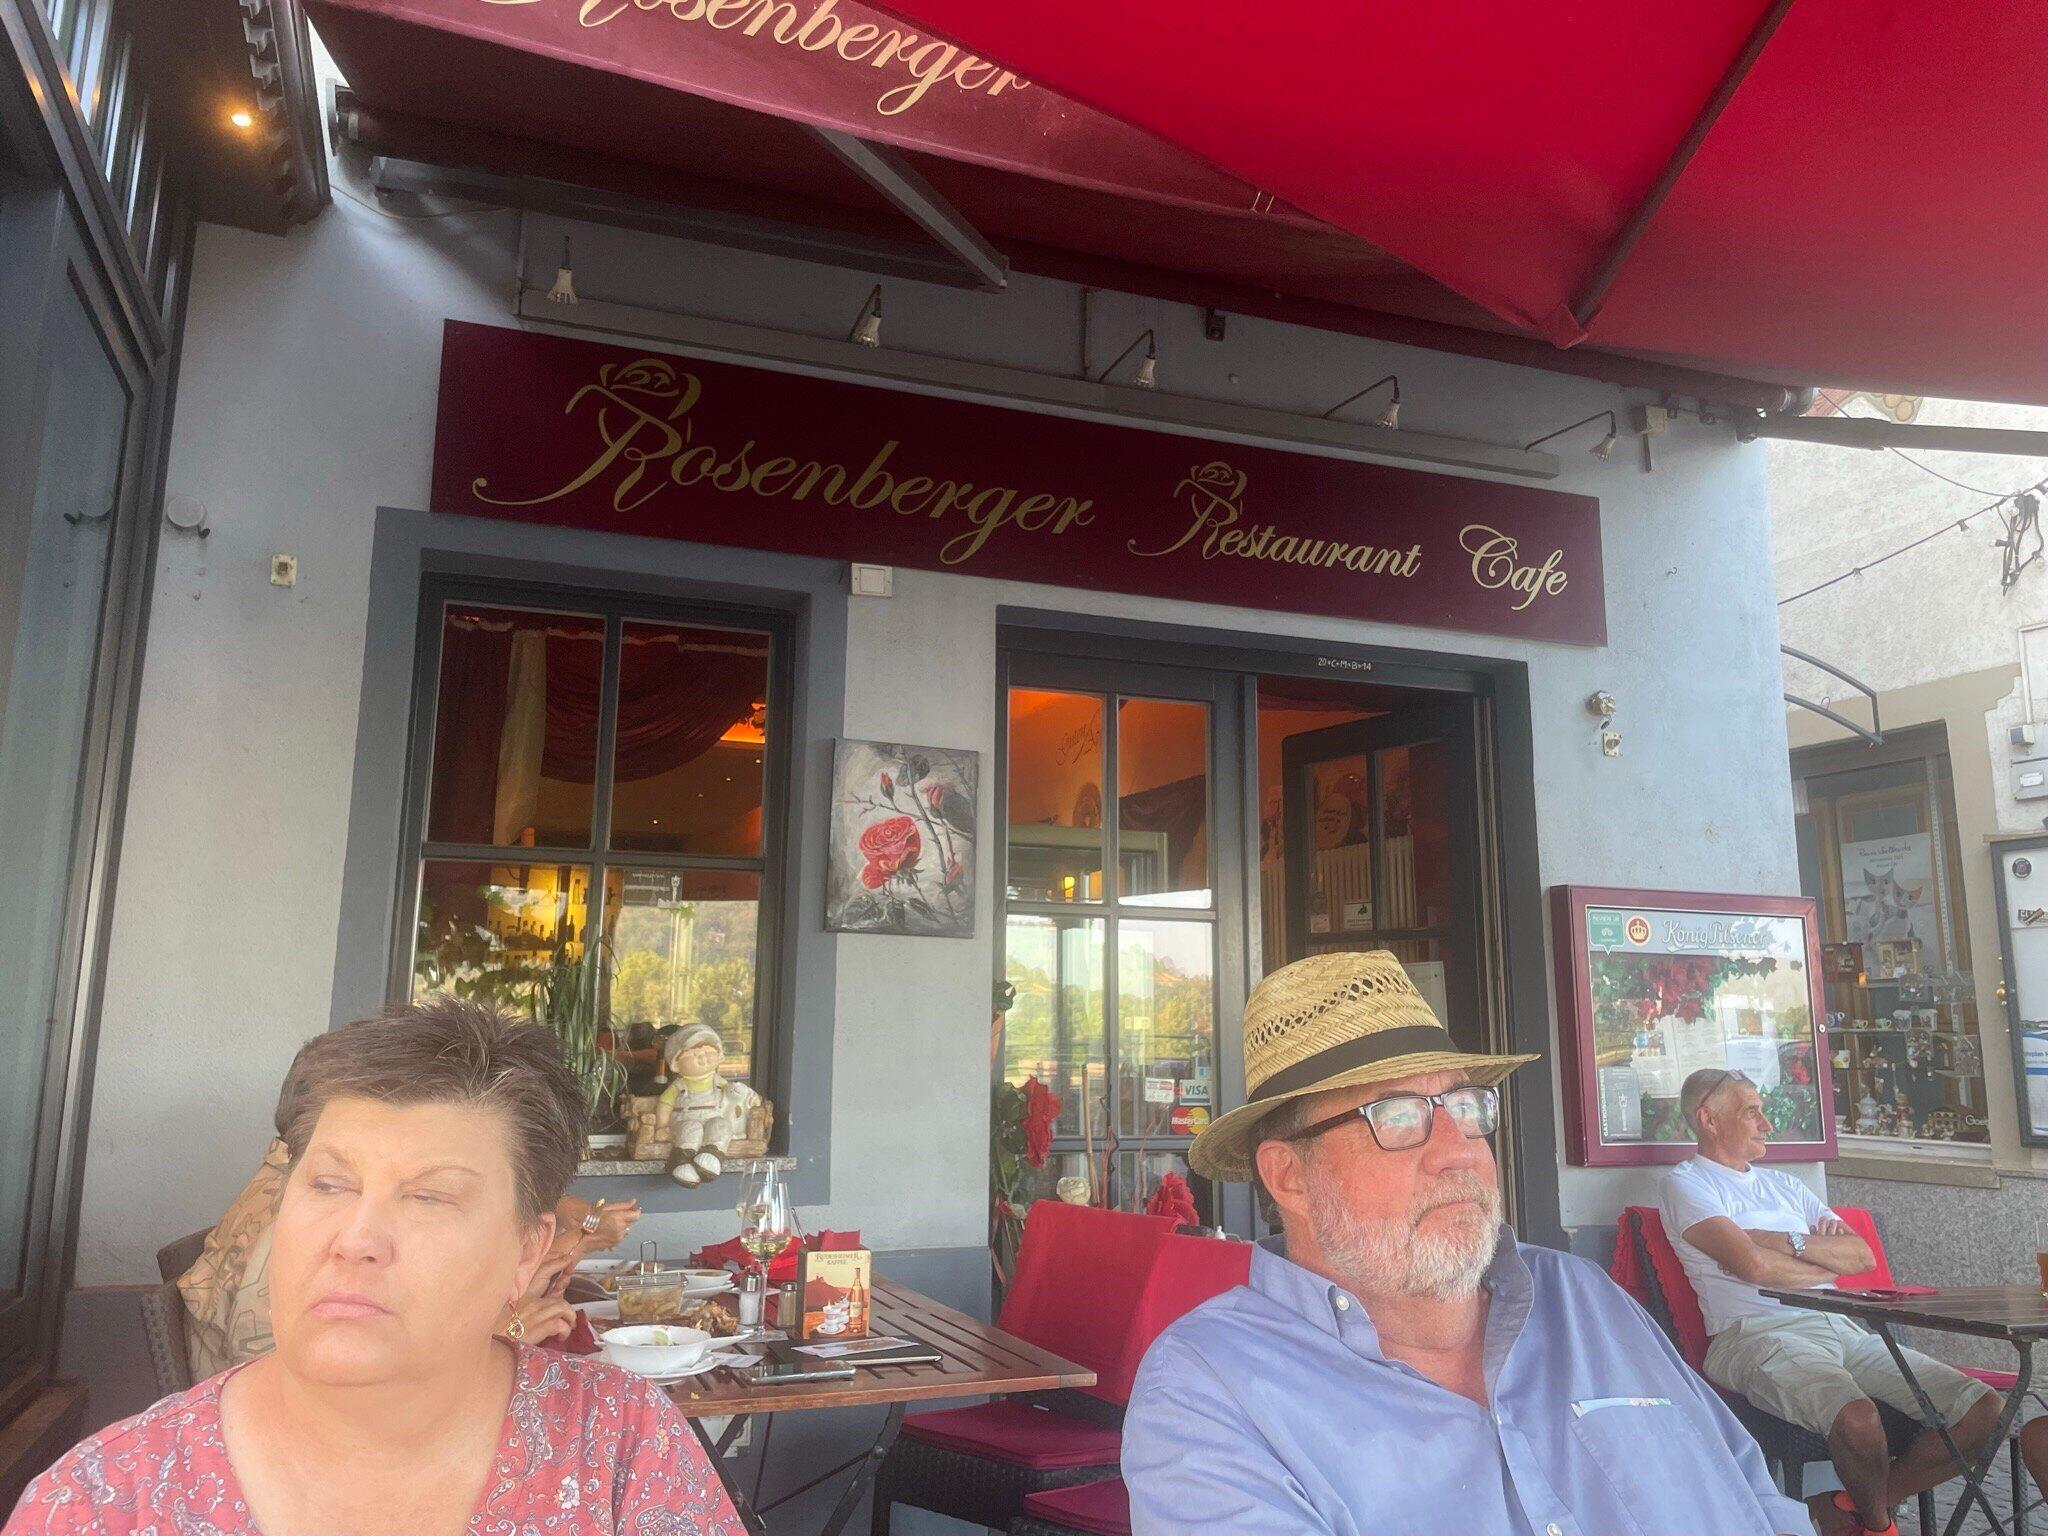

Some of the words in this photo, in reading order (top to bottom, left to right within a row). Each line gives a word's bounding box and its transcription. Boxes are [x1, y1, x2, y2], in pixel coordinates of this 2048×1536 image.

[472, 358, 1094, 565] Rosenberger
[1127, 461, 1421, 578] Restaurant
[1459, 524, 1568, 610] Cafe
[1186, 1085, 1208, 1096] VISA
